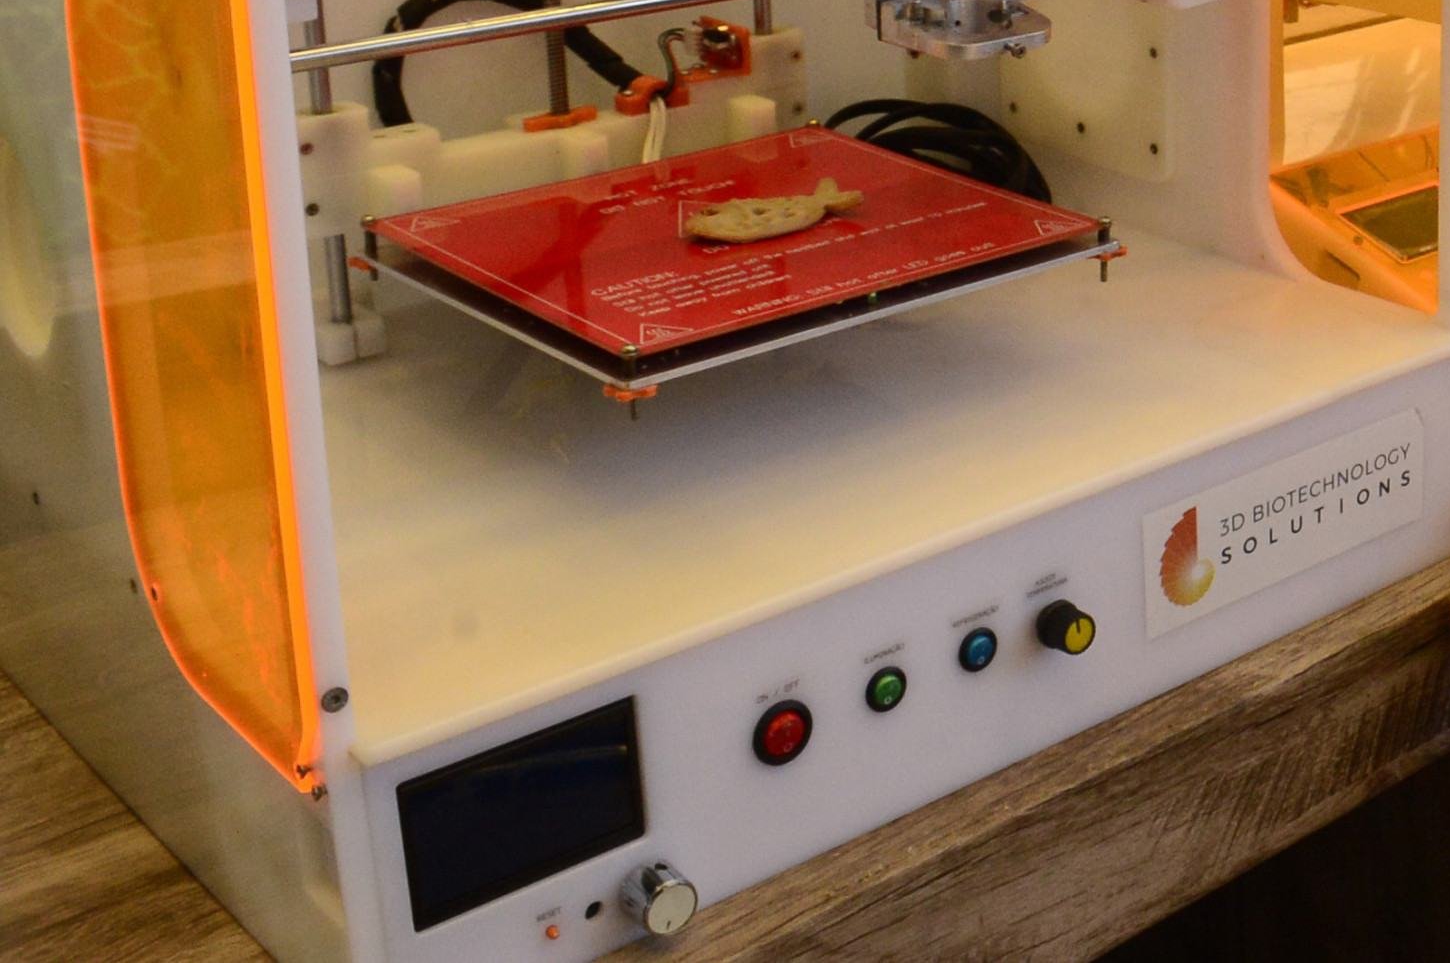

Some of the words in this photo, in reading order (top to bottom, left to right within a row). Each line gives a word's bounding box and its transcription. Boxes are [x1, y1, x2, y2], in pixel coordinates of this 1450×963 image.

[1219, 513, 1246, 537] 3D
[1252, 443, 1411, 524] BIOTECHNOLOGY
[1220, 469, 1411, 565] SOLUTIONS
